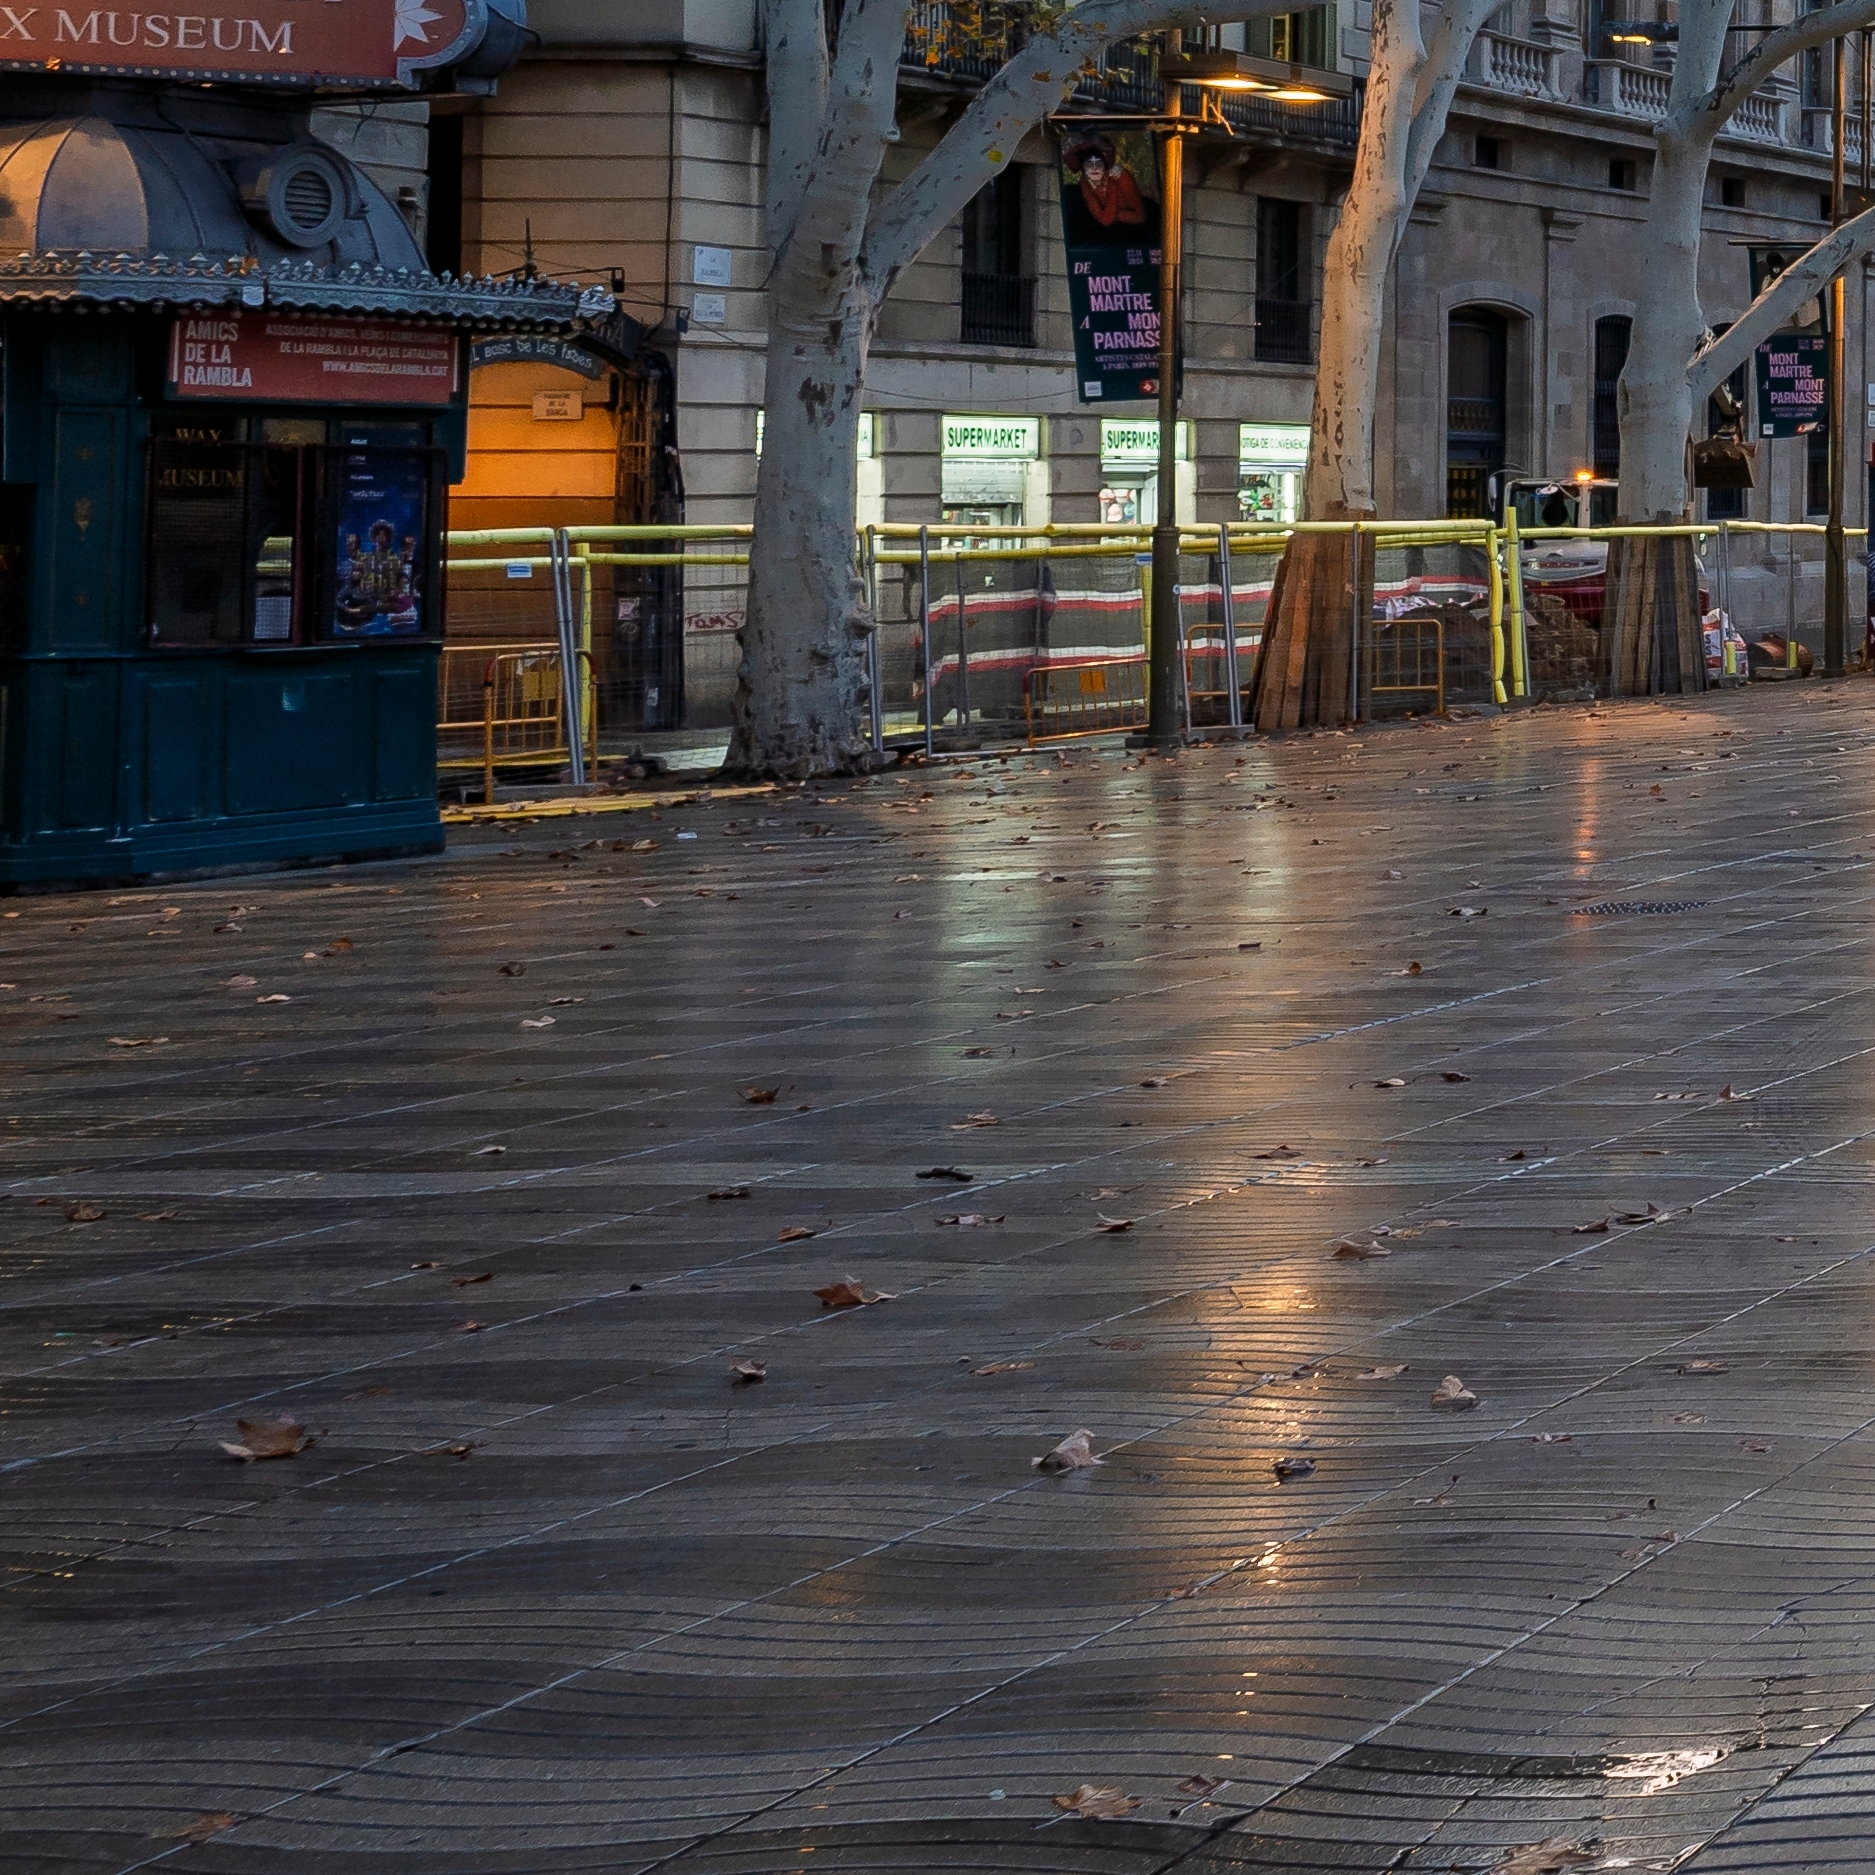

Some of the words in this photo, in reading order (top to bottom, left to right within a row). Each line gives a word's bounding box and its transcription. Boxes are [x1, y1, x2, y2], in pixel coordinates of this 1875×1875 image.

[54, 9, 296, 54] MUSEUM
[1074, 262, 1092, 274] DE
[1090, 293, 1153, 312] MARTRE
[186, 320, 239, 342] AMICS
[1080, 315, 1090, 329] A
[1127, 312, 1160, 330] MON
[1093, 330, 1160, 350] PARNASS
[1760, 344, 1772, 352] DE
[185, 343, 206, 364] DE
[211, 344, 232, 364] LA
[184, 365, 253, 387] RAMBLA
[1770, 365, 1813, 377] MARTRE
[1770, 392, 1825, 404] PARNASSE
[947, 427, 1027, 449] SUPERMARKET
[1107, 429, 1160, 450] SUPERMAR
